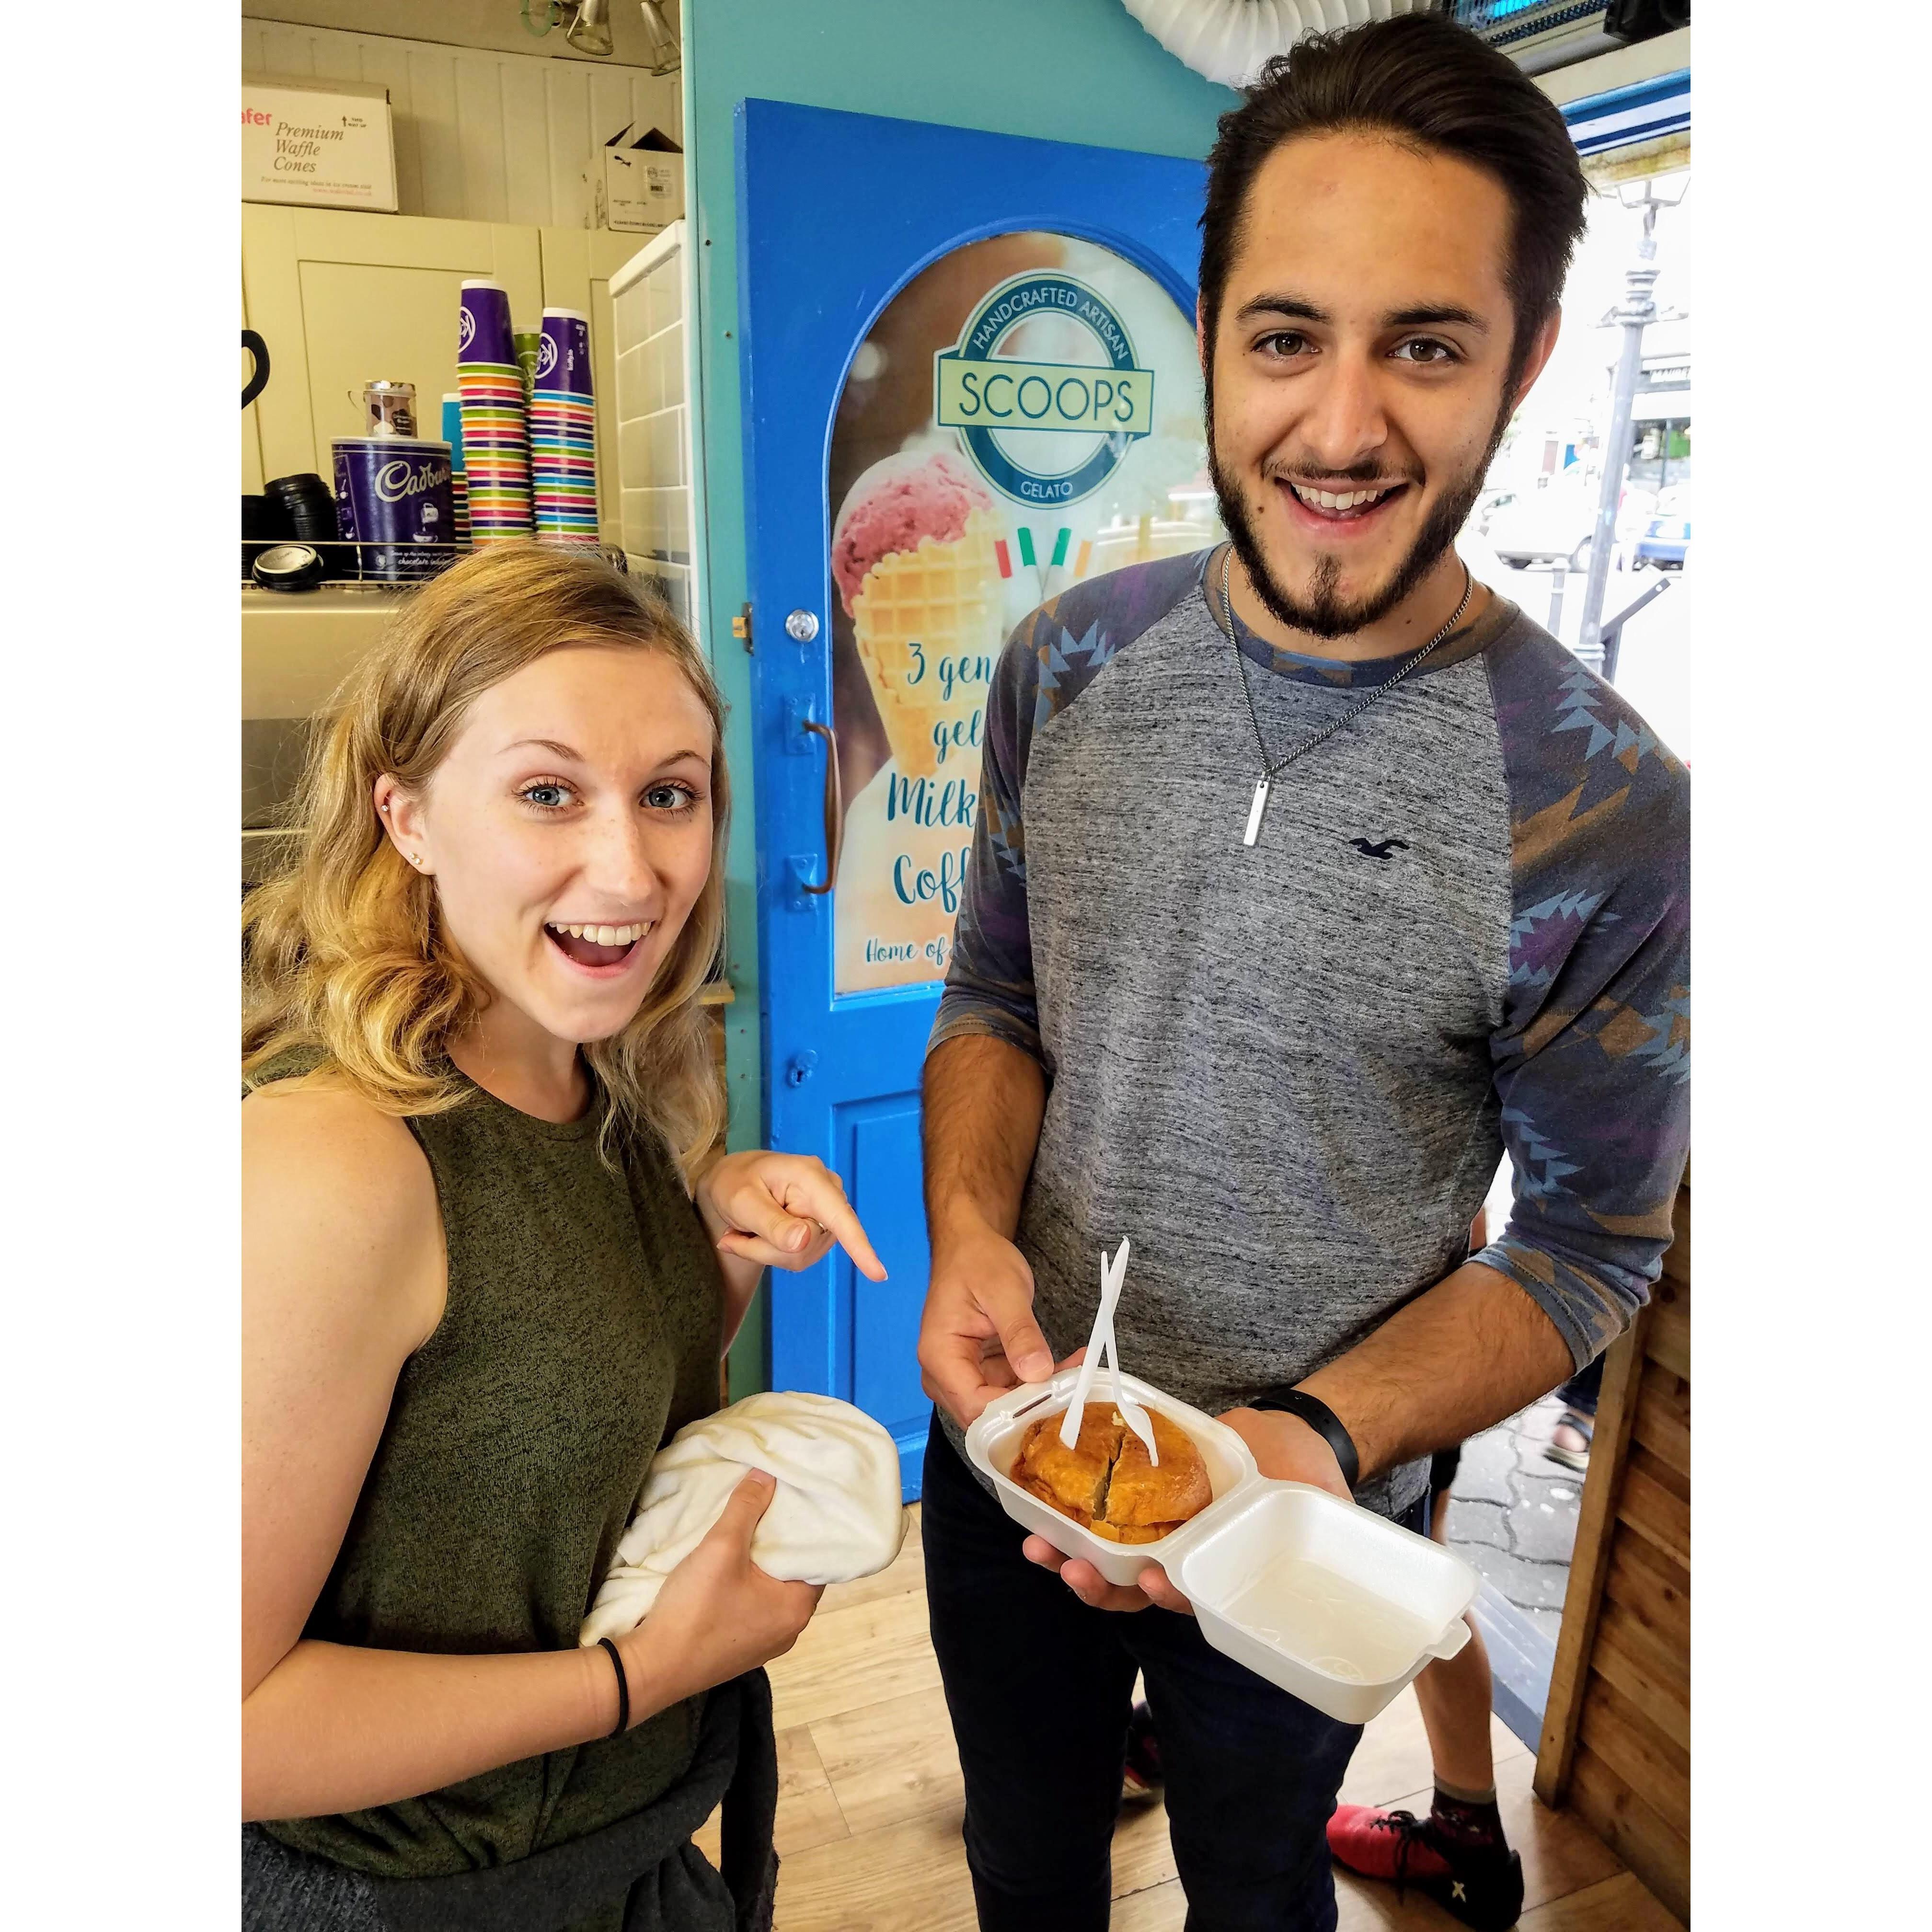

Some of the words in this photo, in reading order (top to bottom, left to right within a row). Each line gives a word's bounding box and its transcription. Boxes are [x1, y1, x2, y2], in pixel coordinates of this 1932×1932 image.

[275, 122, 344, 140] Premium
[276, 139, 321, 158] Waffle
[274, 156, 317, 172] Cones
[973, 288, 1078, 349] HANDCRAFTED
[1079, 300, 1129, 361] ARTISAN
[959, 372, 1134, 422] SCOOPS
[375, 460, 449, 502] Cadbu
[1021, 481, 1074, 499] GELATO
[908, 643, 926, 685] 3
[939, 656, 991, 701] gen
[934, 709, 984, 764] gel
[888, 772, 976, 828] Milk
[866, 938, 919, 962] Home
[926, 937, 948, 966] of
